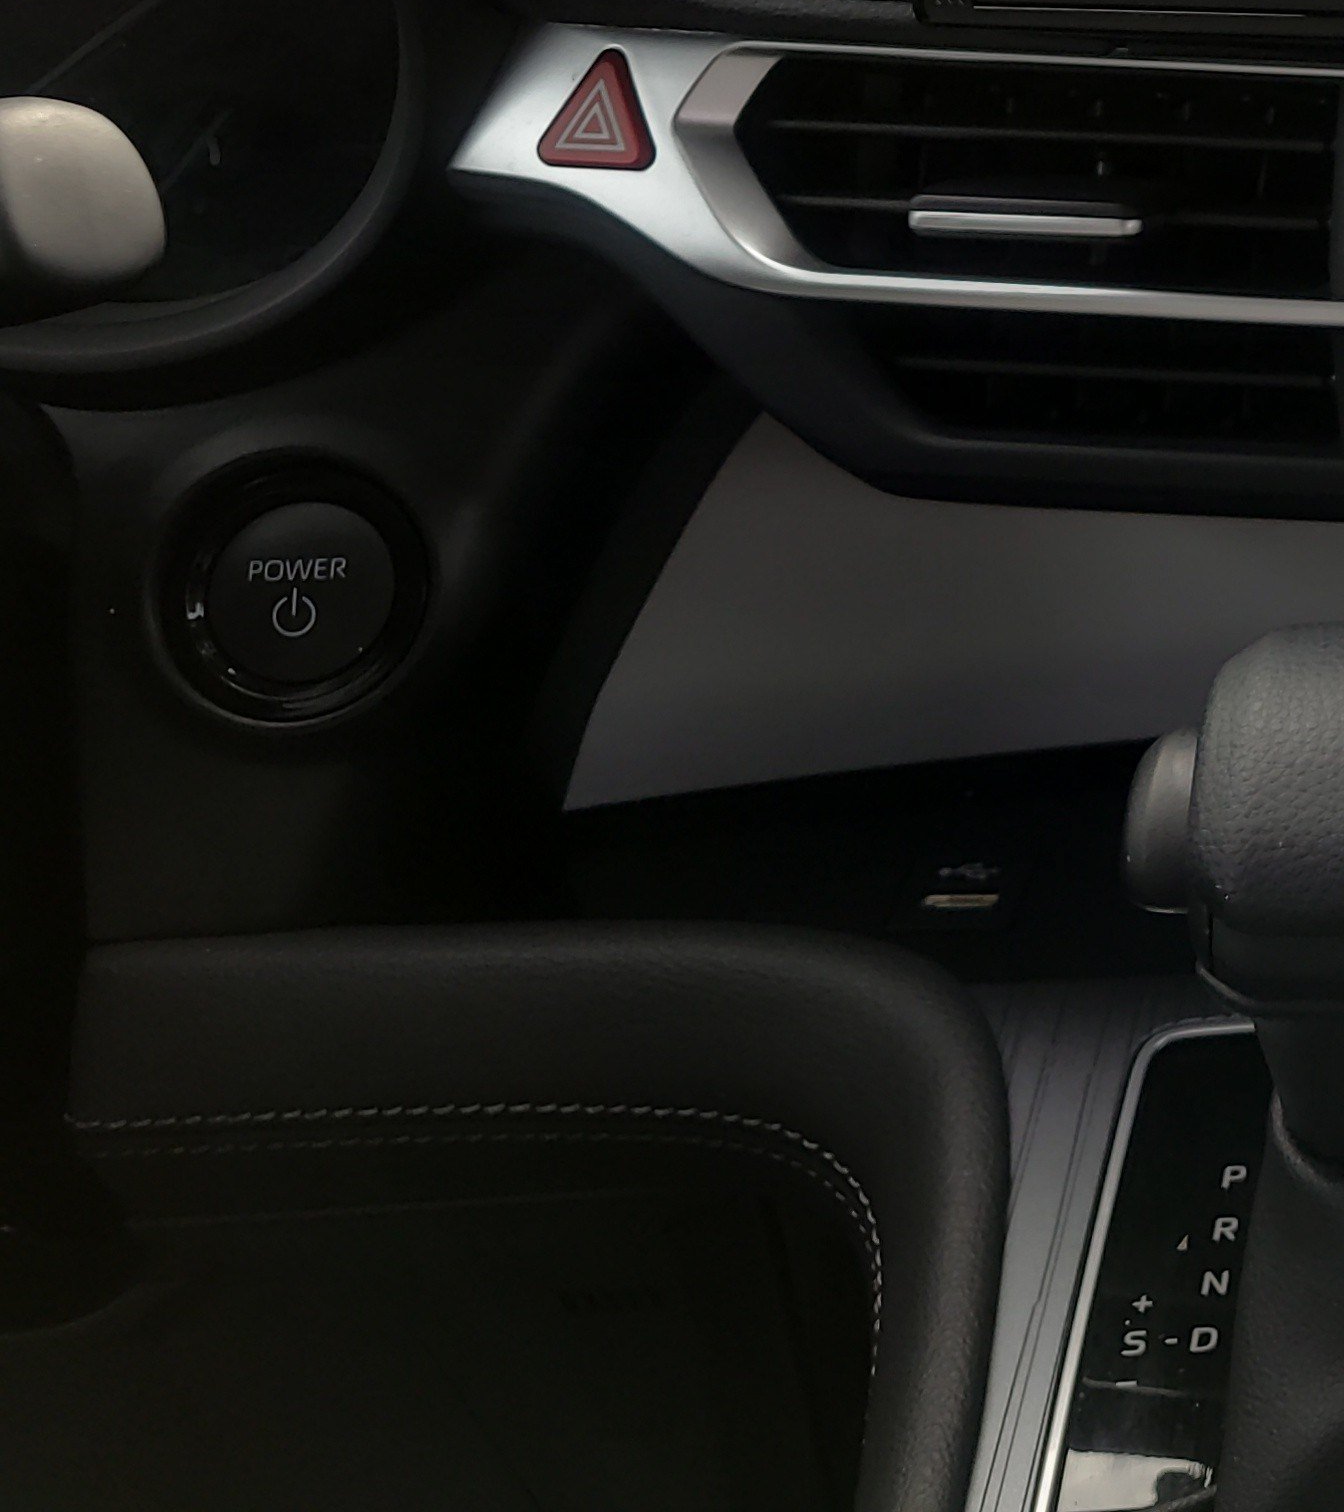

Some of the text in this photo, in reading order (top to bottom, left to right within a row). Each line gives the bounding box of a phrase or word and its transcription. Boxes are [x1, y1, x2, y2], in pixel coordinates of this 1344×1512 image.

[248, 557, 347, 583] POWER
[1220, 1165, 1247, 1190] P
[1212, 1216, 1239, 1242] R
[1200, 1269, 1230, 1296] N
[1120, 1330, 1147, 1357] S
[1189, 1326, 1219, 1353] D
